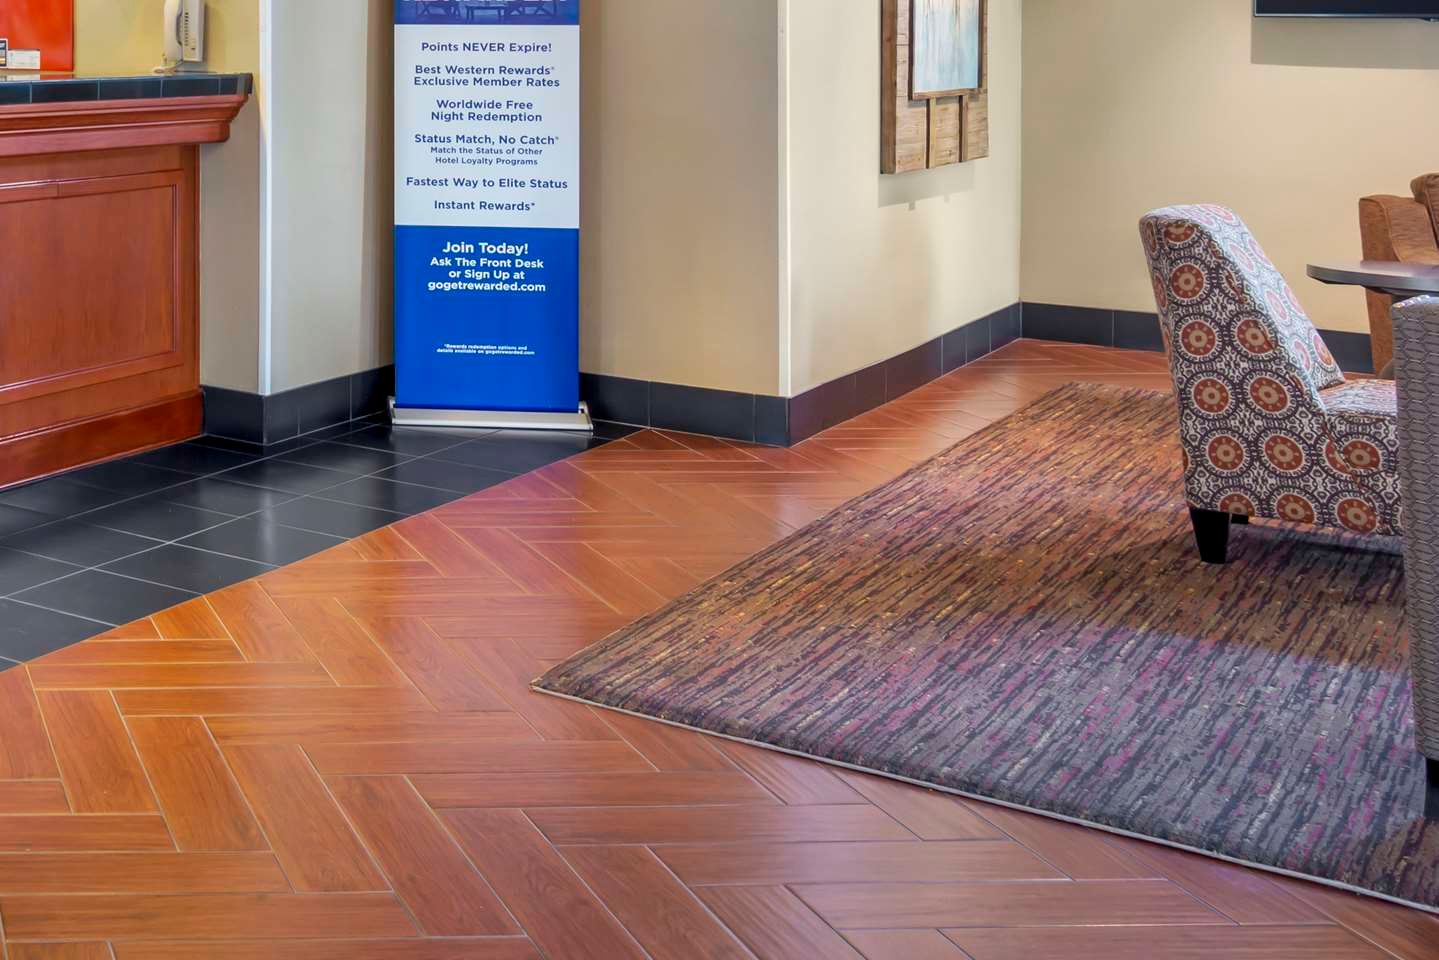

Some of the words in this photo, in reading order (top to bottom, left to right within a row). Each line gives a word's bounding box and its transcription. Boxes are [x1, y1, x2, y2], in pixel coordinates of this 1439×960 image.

[422, 43, 458, 52] Points
[463, 43, 504, 51] NEVER
[510, 43, 552, 54] Expire!
[415, 66, 441, 74] Best
[446, 66, 494, 74] Western
[414, 77, 468, 86] Exclusive
[473, 77, 522, 86] Member
[527, 78, 560, 87] Rates
[437, 100, 502, 109] Worldwide
[507, 101, 533, 109] Free
[431, 112, 464, 122] Night
[468, 112, 542, 122] Redemption
[415, 134, 451, 143] Status
[456, 135, 494, 145] Match,
[499, 136, 515, 144] No
[462, 157, 493, 165] Loyalty
[406, 177, 448, 186] Fastest
[453, 178, 478, 188] Way
[483, 179, 494, 187] to
[499, 179, 525, 187] Elite
[530, 179, 567, 188] Status
[434, 201, 475, 210] Instant
[443, 242, 474, 253] Join
[479, 243, 528, 256] Today!
[430, 257, 451, 266] Ask
[455, 258, 476, 266] The
[480, 258, 511, 267] Front
[515, 259, 543, 268] Desk
[464, 270, 490, 280] Sign
[494, 270, 509, 280] Up
[513, 271, 524, 279] at
[428, 281, 545, 292] gogetrewarded.com
